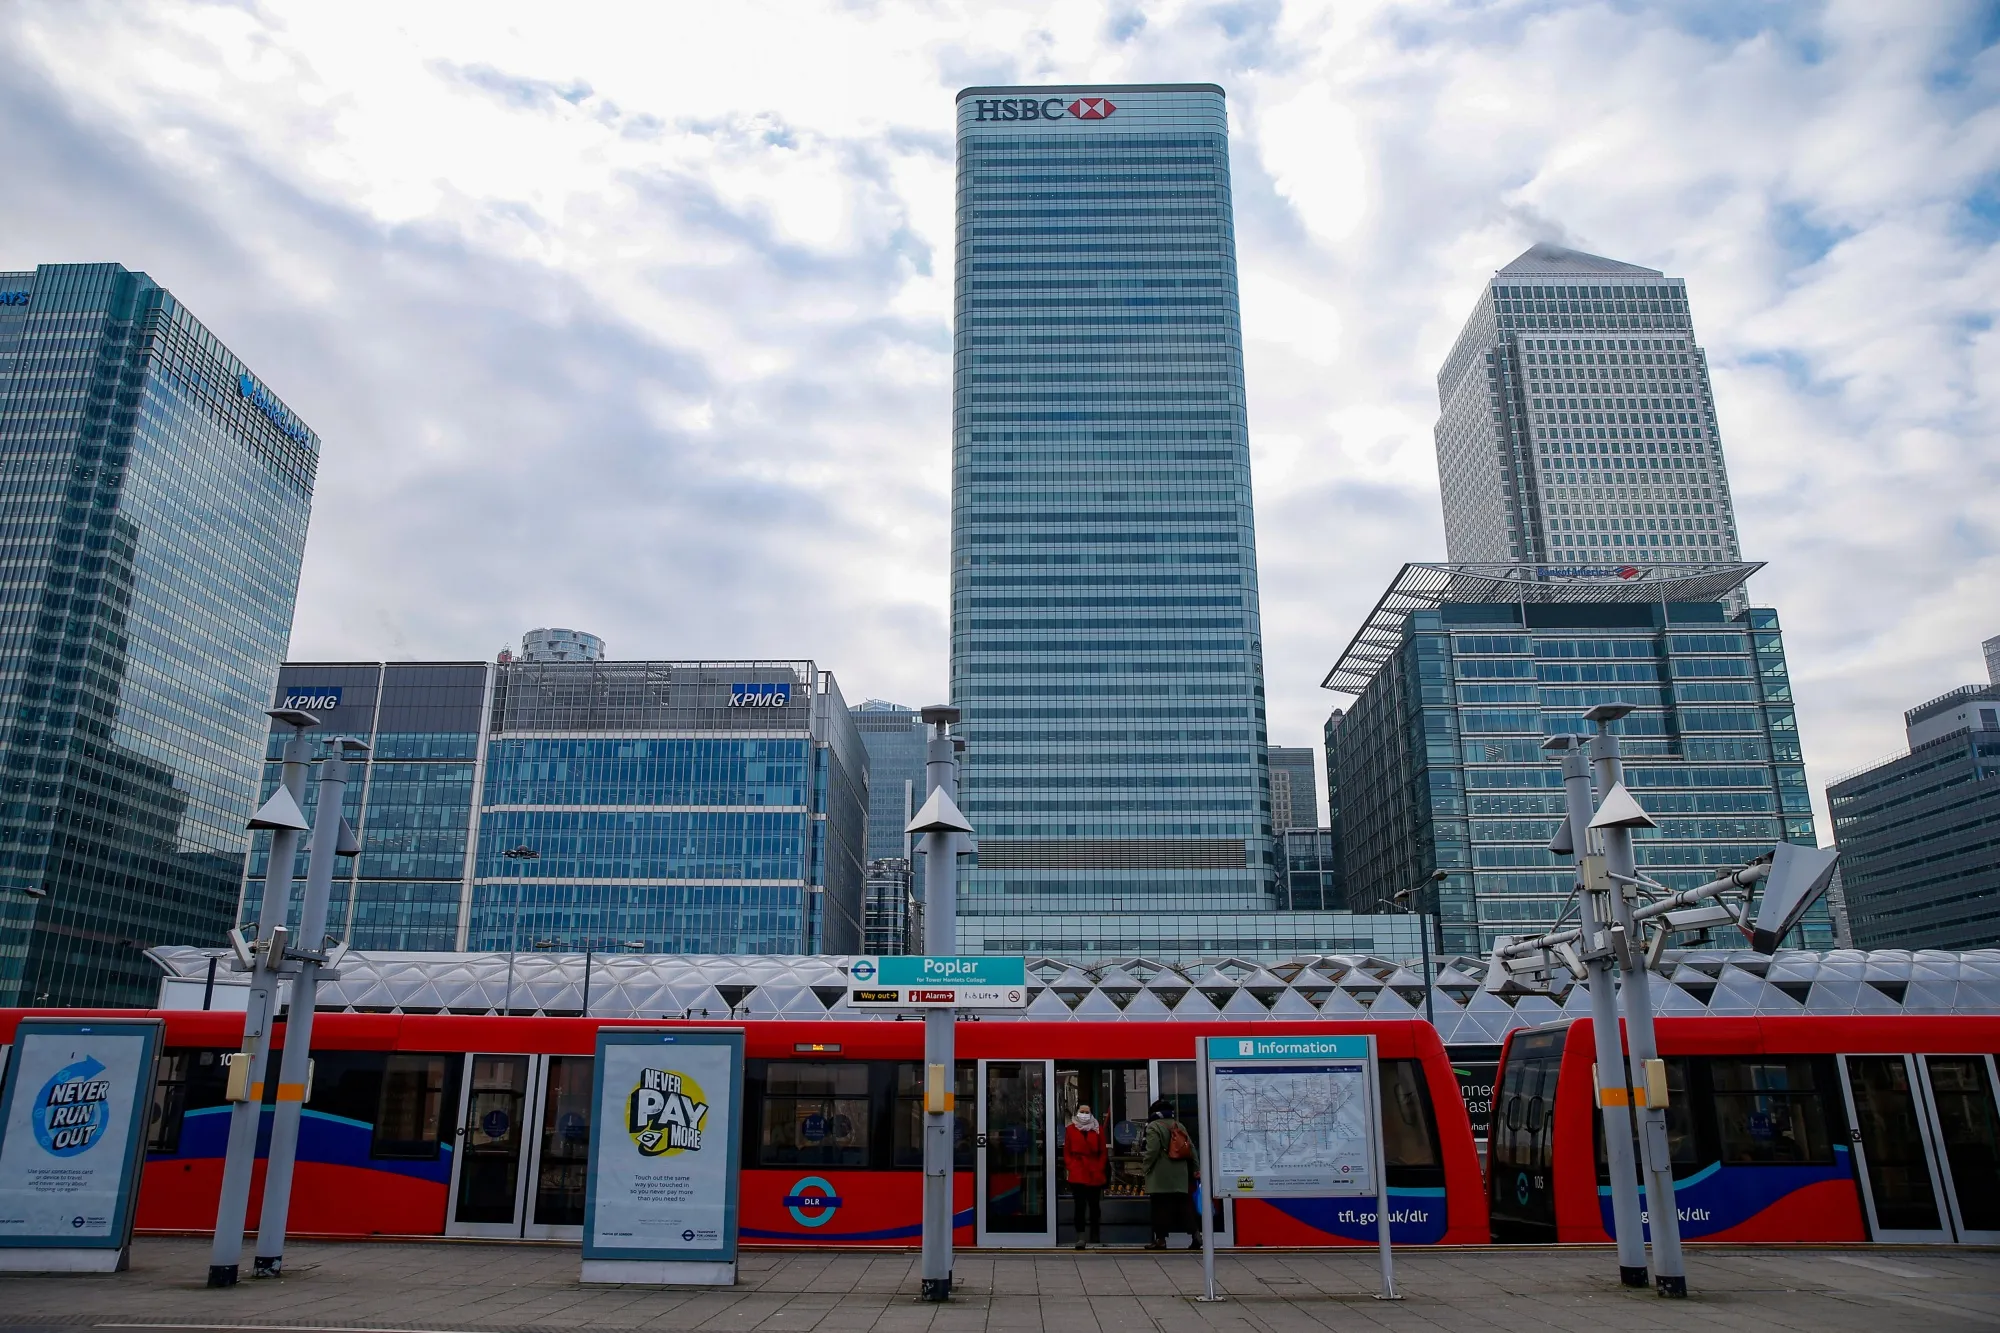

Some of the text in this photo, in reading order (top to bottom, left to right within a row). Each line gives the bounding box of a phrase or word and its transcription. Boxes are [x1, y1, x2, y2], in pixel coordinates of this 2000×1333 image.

[975, 98, 1064, 121] HSBC
[252, 388, 309, 450] BARCLAYS
[282, 695, 338, 710] KPMG
[727, 692, 786, 708] KPMG
[924, 958, 979, 977] Poplar
[861, 992, 876, 1000] Way
[1258, 1041, 1337, 1054] Information
[219, 1053, 233, 1066] 10
[644, 1068, 681, 1094] NEVER
[50, 1081, 109, 1104] NEVER
[52, 1105, 94, 1127] RUN
[637, 1089, 707, 1130] PAY
[55, 1125, 97, 1148] OUT
[671, 1125, 701, 1148] MORE
[804, 1198, 820, 1206] DLR
[1338, 1209, 1429, 1225] tfl.gouk/dlr
